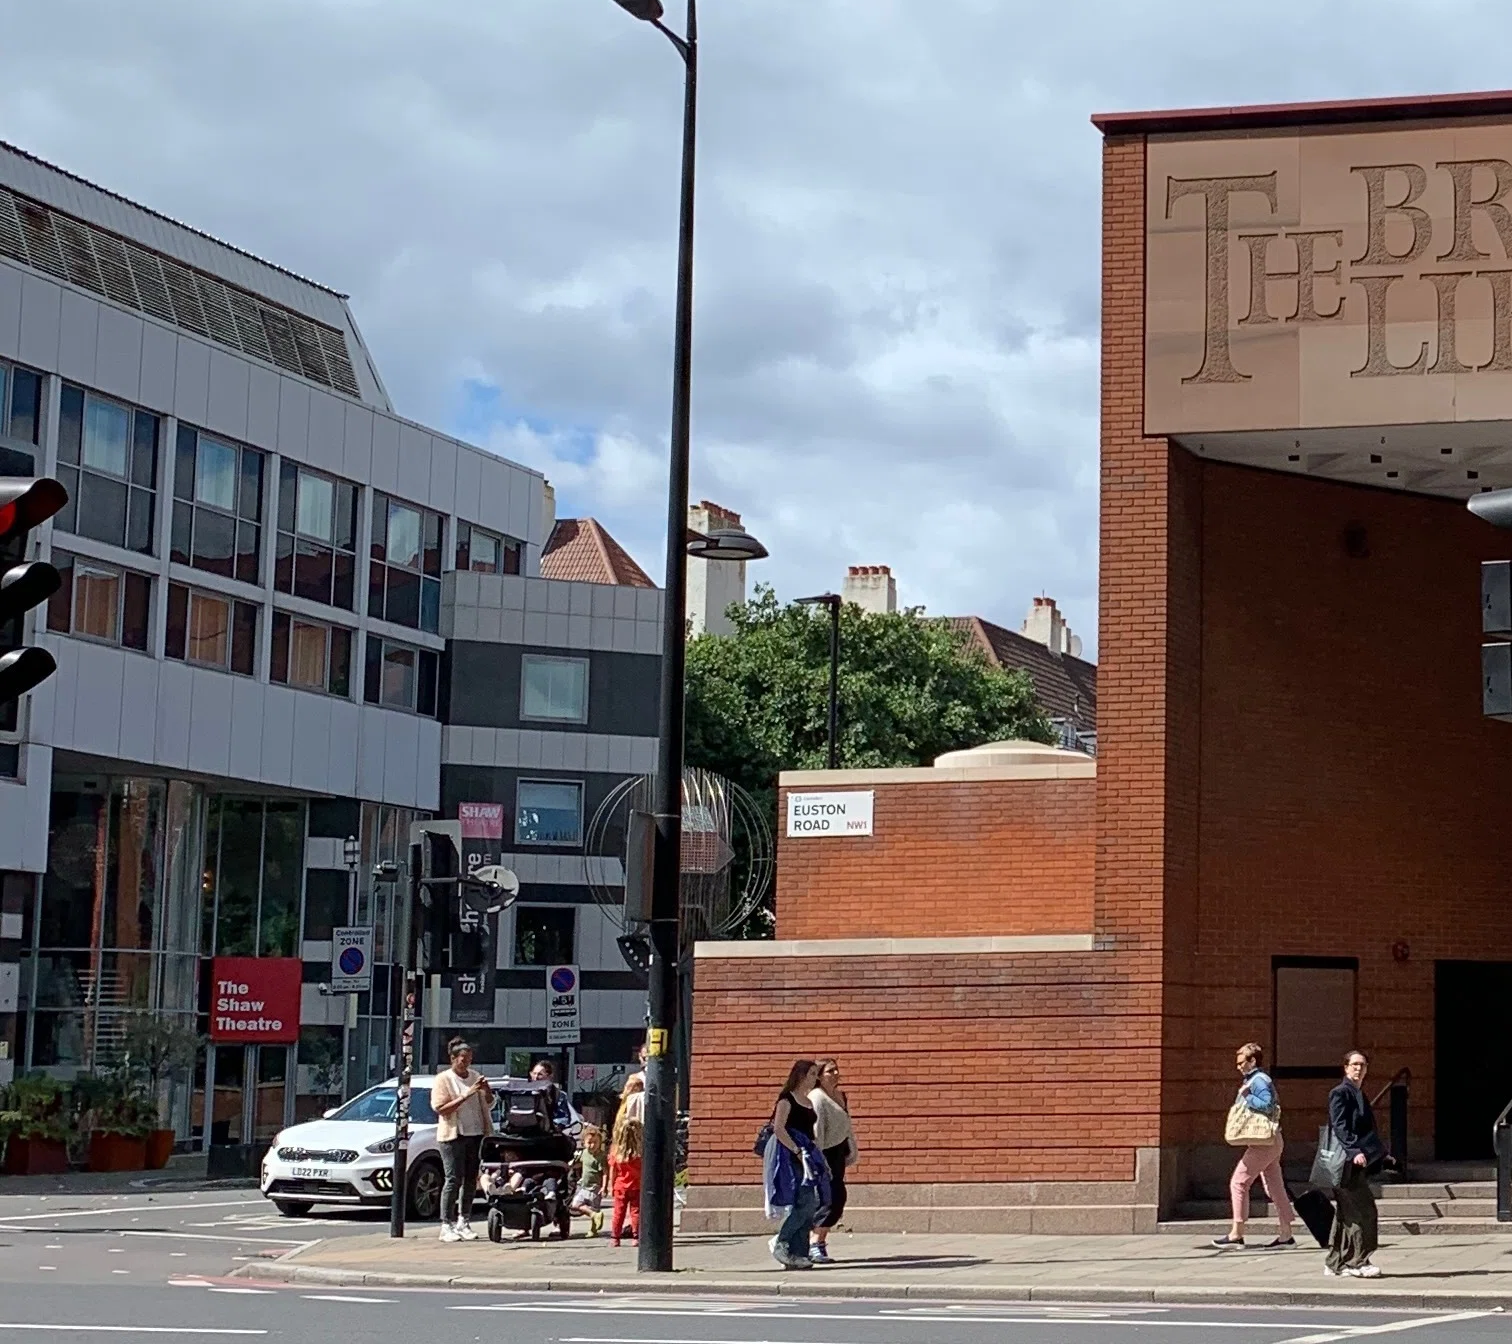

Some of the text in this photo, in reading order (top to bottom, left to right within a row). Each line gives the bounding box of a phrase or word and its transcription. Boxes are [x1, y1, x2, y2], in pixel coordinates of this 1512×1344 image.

[1165, 169, 1347, 385] THE
[462, 806, 501, 818] SHAW
[794, 804, 846, 816] EUSTON
[794, 820, 867, 831] ROAD NW1
[340, 937, 365, 946] ZONE
[218, 980, 249, 995] The
[217, 998, 265, 1012] Shaw
[216, 1017, 283, 1031] Theatre
[552, 1020, 576, 1029] ZONE
